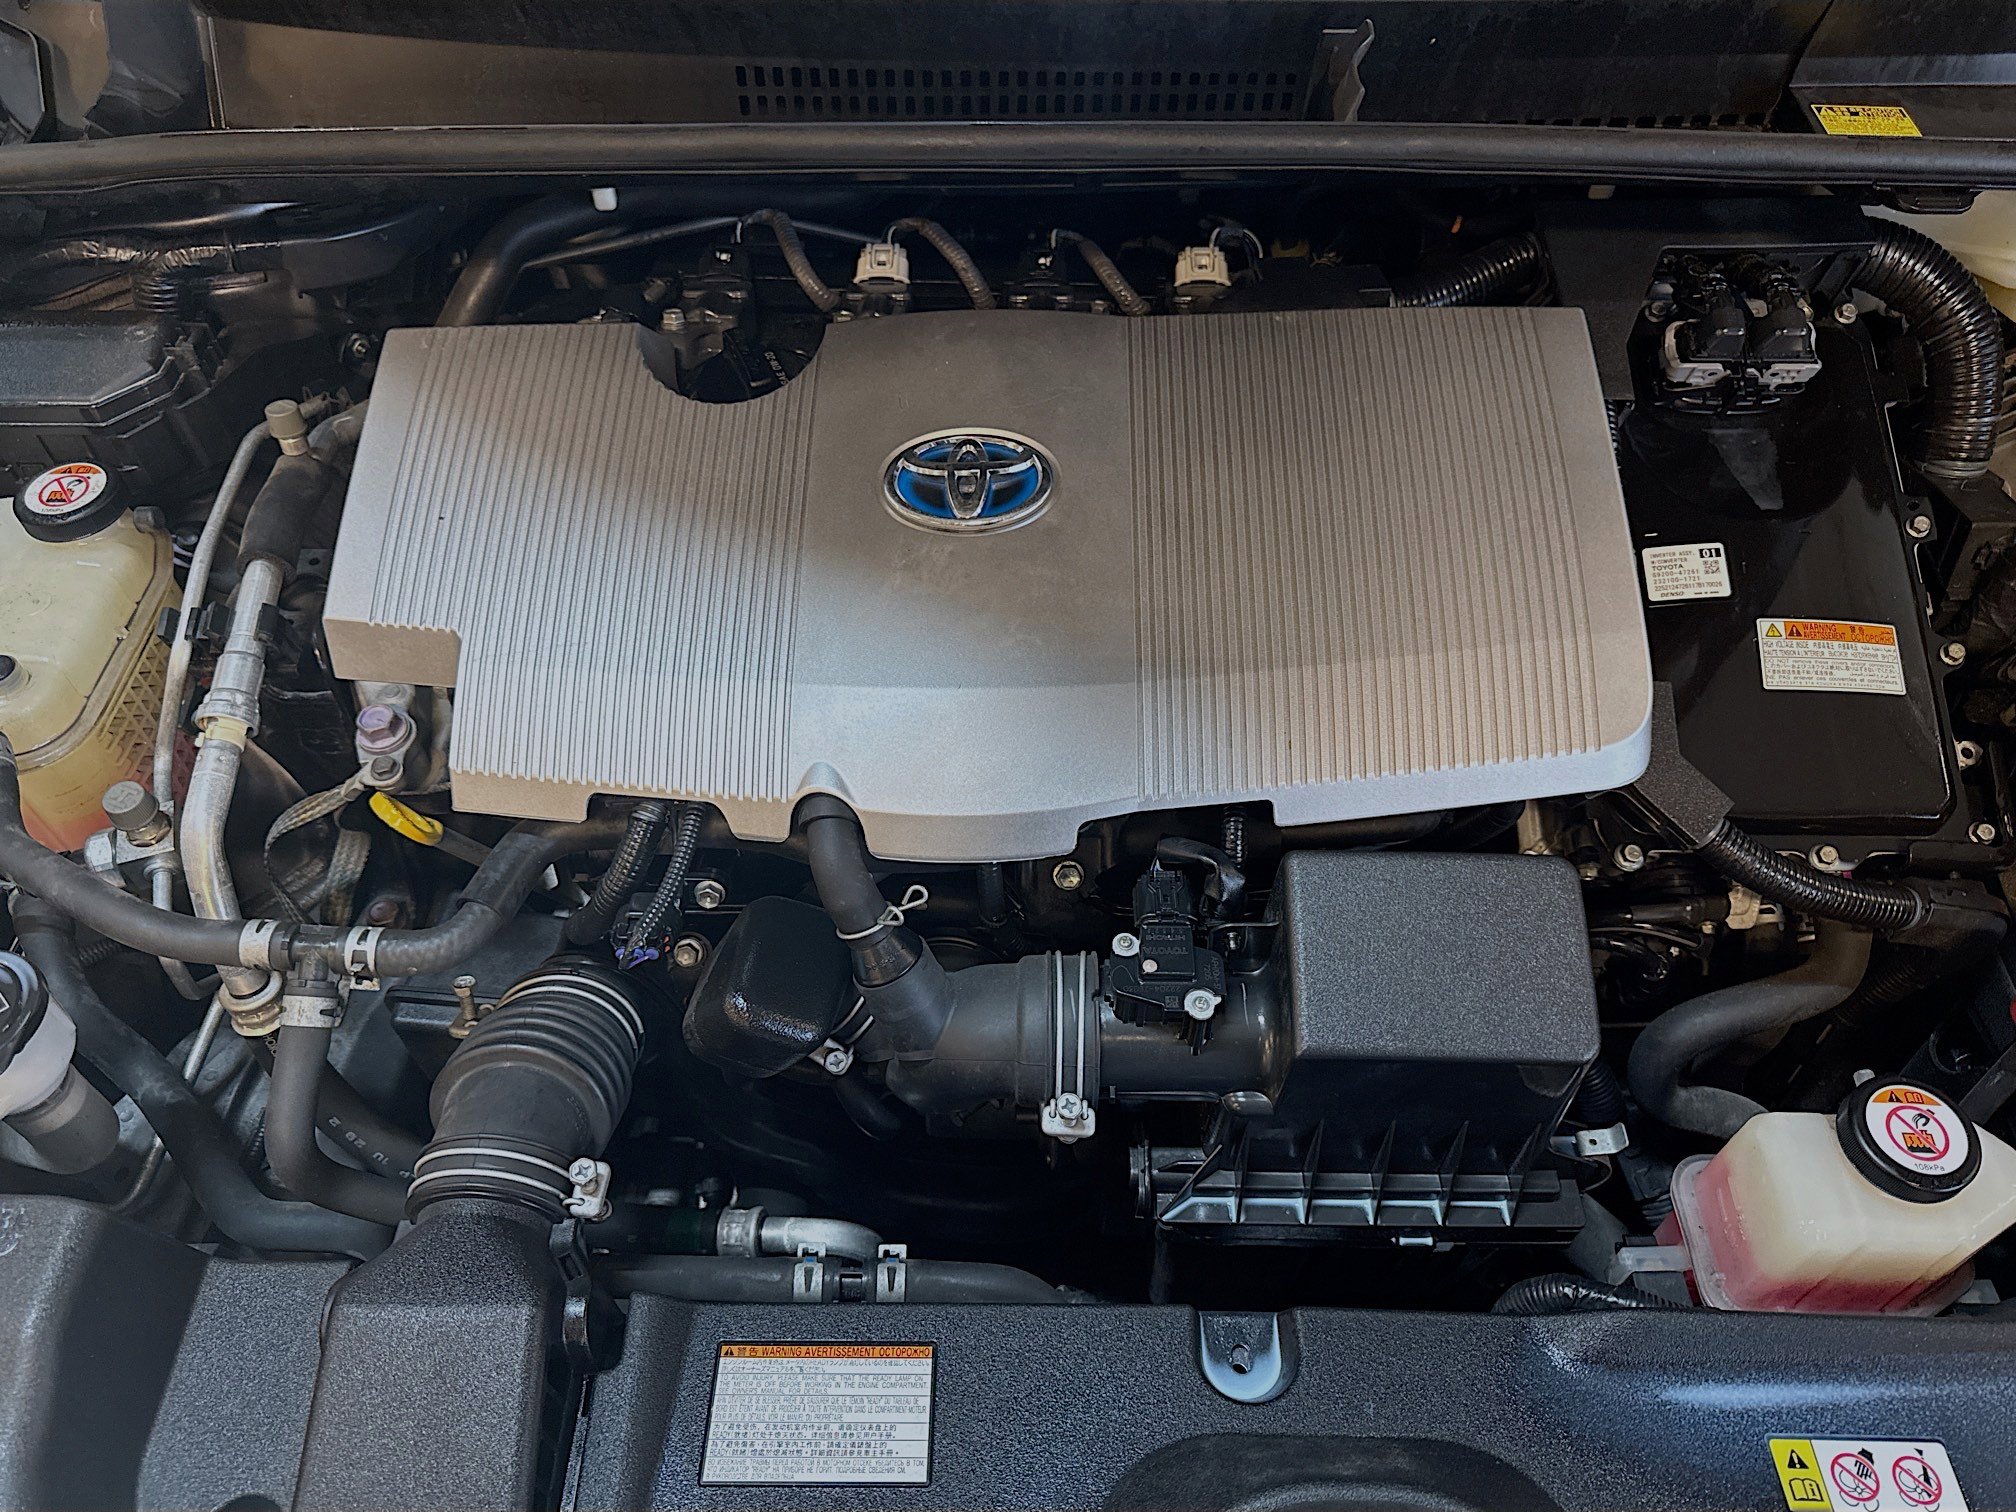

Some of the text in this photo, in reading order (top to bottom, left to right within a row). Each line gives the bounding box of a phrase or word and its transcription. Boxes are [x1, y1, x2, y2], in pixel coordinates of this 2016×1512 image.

[1702, 549, 1716, 557] 01
[1652, 563, 1684, 571] TOYOTA
[1802, 623, 1837, 632] WARNING
[1803, 631, 1846, 640] AVERTISSEMENT
[1142, 946, 1190, 955] TOYOTA
[1913, 1163, 1946, 1172] 108kPa
[762, 1347, 802, 1356] WARNING
[804, 1347, 875, 1356] AVERTISSEMENT
[879, 1347, 930, 1357] ОСТОРОЖНО
